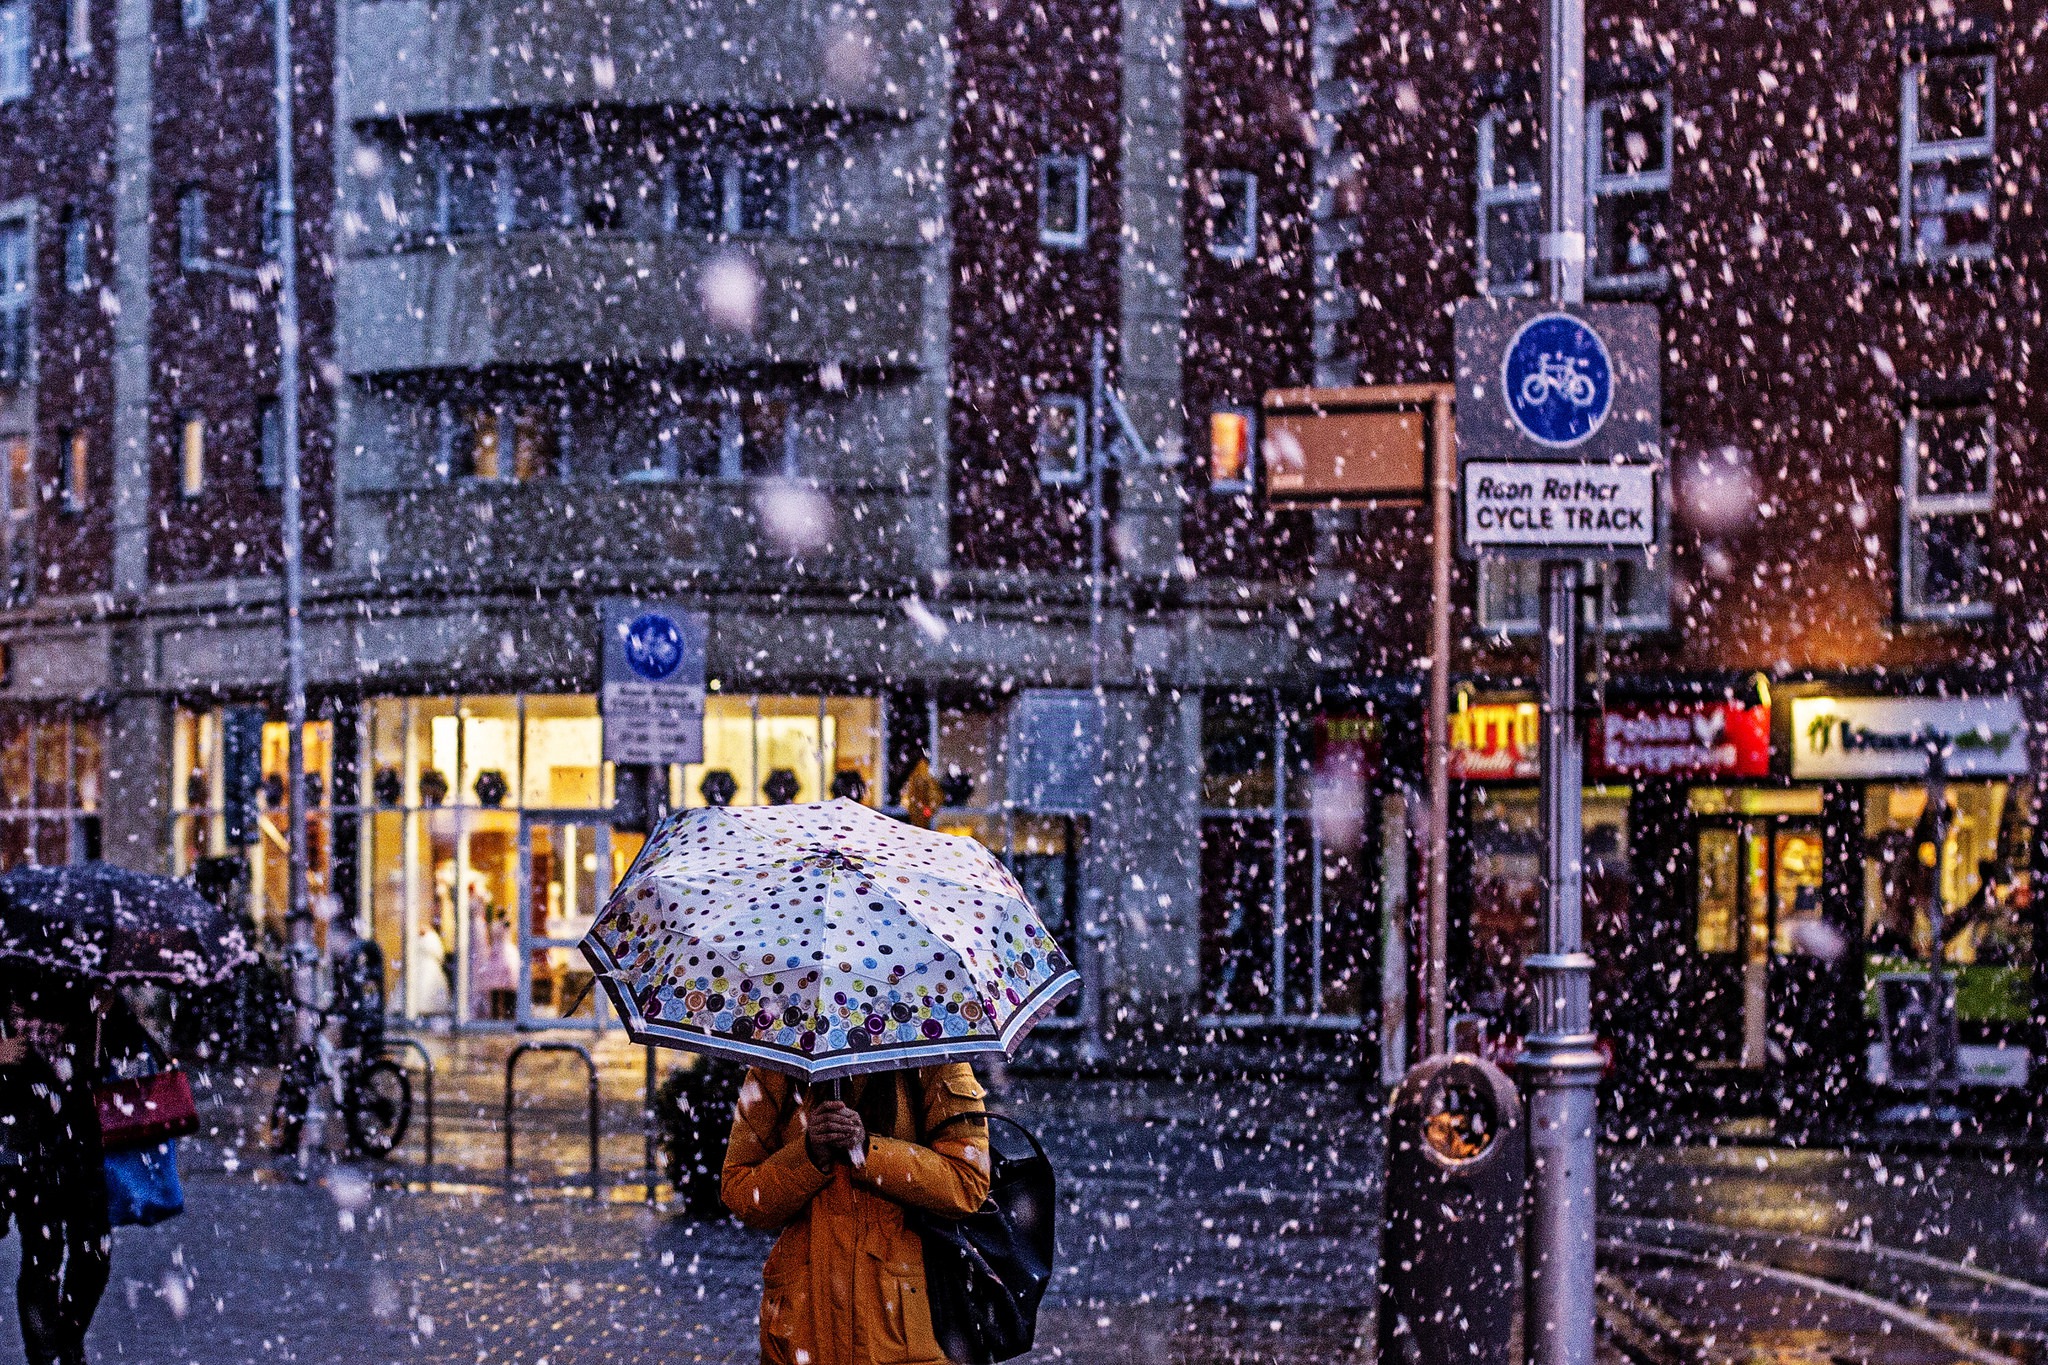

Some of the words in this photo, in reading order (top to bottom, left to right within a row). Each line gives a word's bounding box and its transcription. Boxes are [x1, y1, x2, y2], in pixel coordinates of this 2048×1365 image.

[1477, 506, 1553, 530] CYCLE
[1564, 507, 1644, 531] TRACK
[1447, 703, 1538, 749] ATTO
